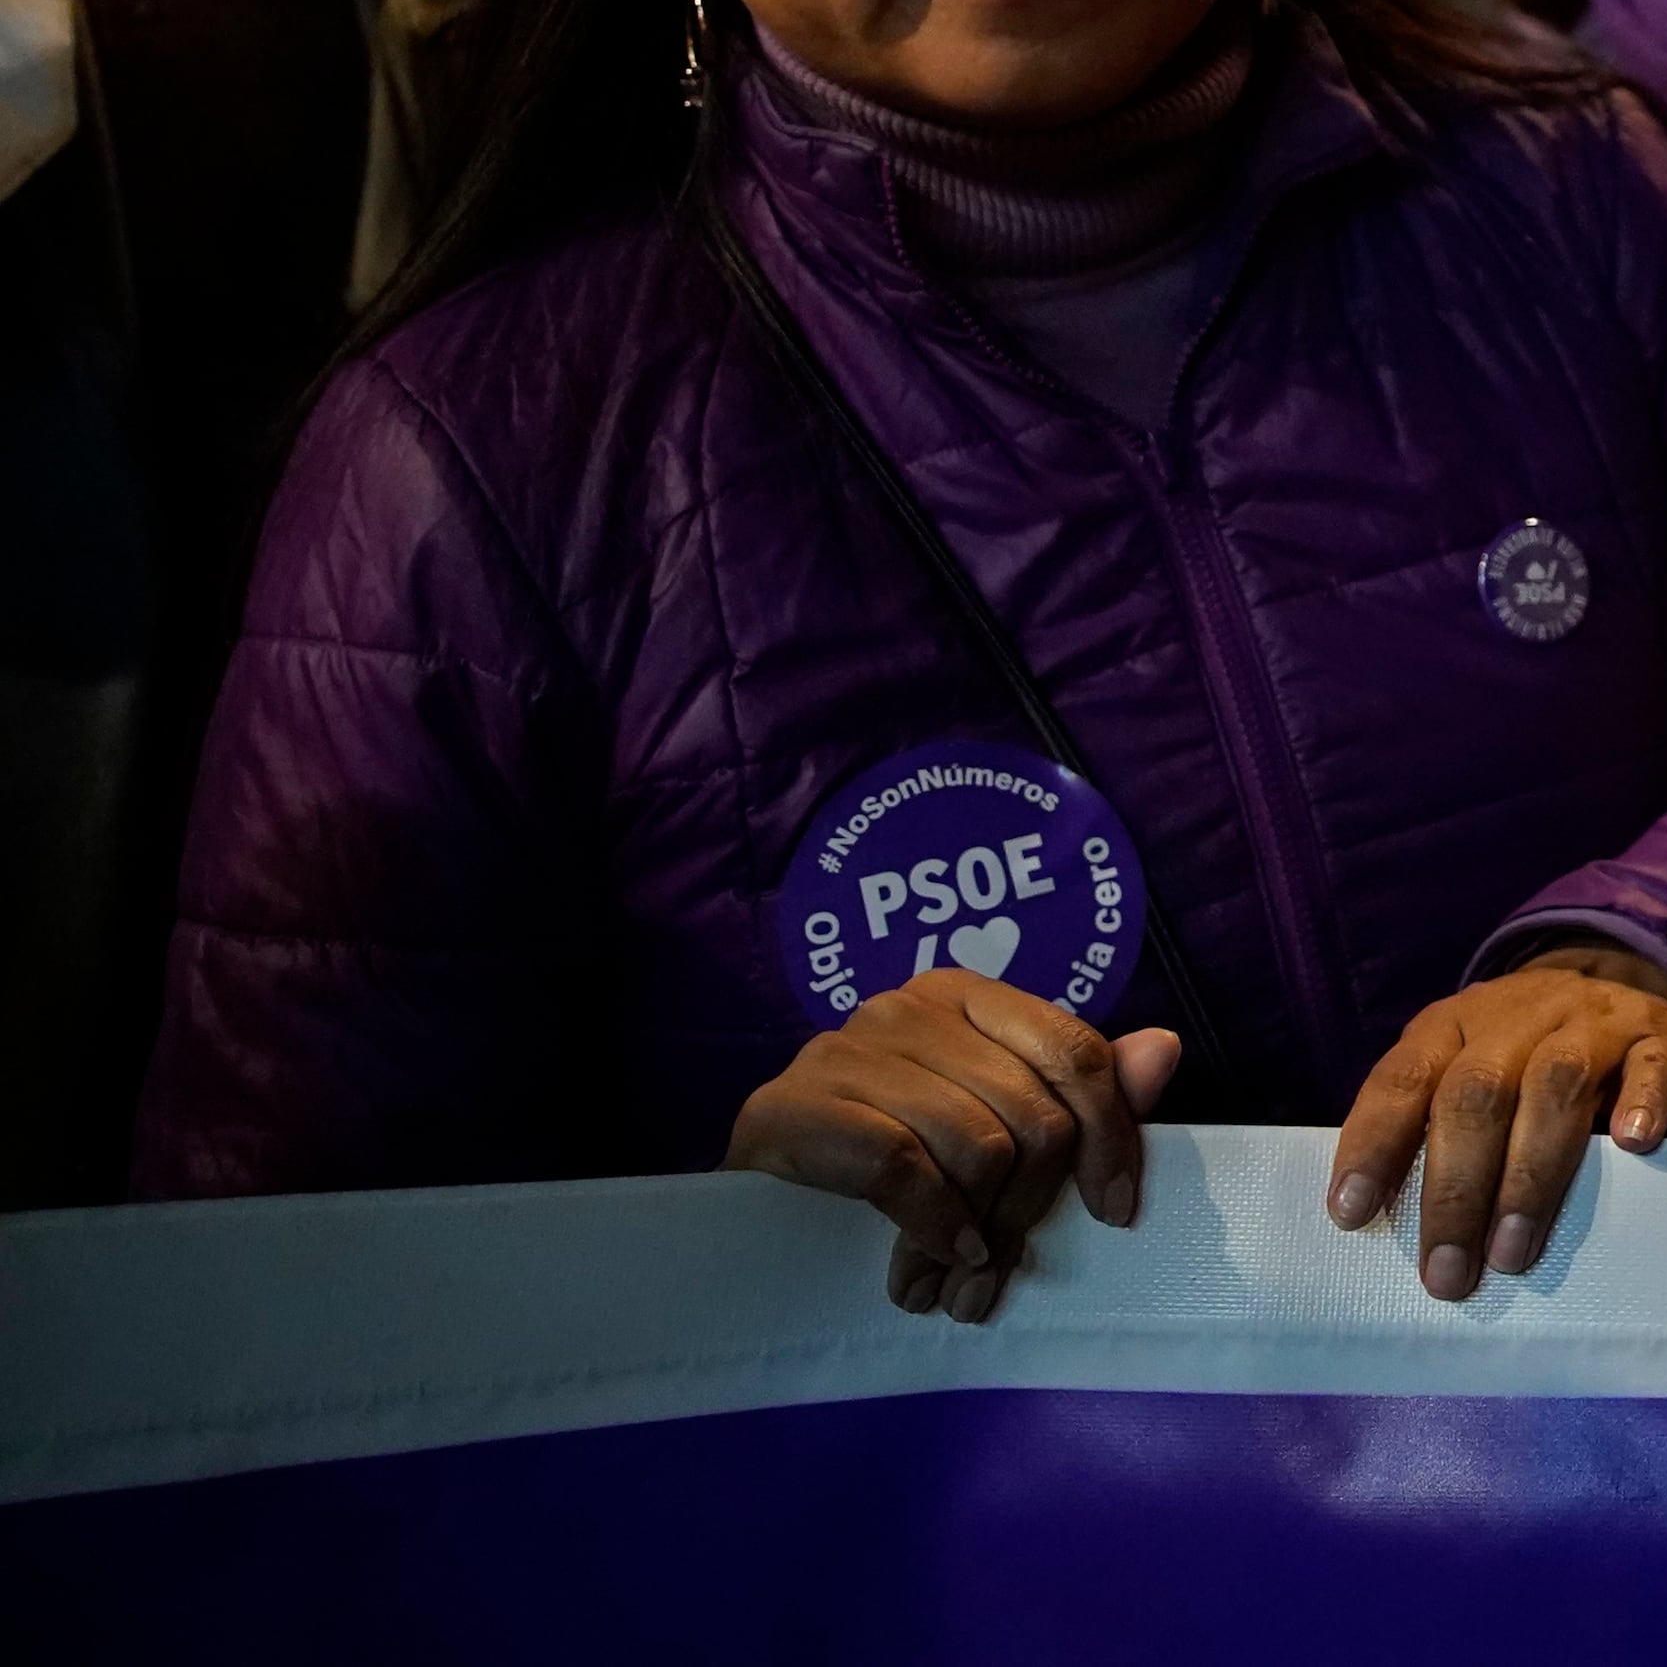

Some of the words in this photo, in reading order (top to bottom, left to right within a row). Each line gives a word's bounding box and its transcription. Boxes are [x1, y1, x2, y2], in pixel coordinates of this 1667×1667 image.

[818, 763, 1060, 874] #NoSonNúmeros
[804, 911, 864, 1013] Obje
[1083, 836, 1123, 935] cero
[859, 833, 1055, 940] PSOE
